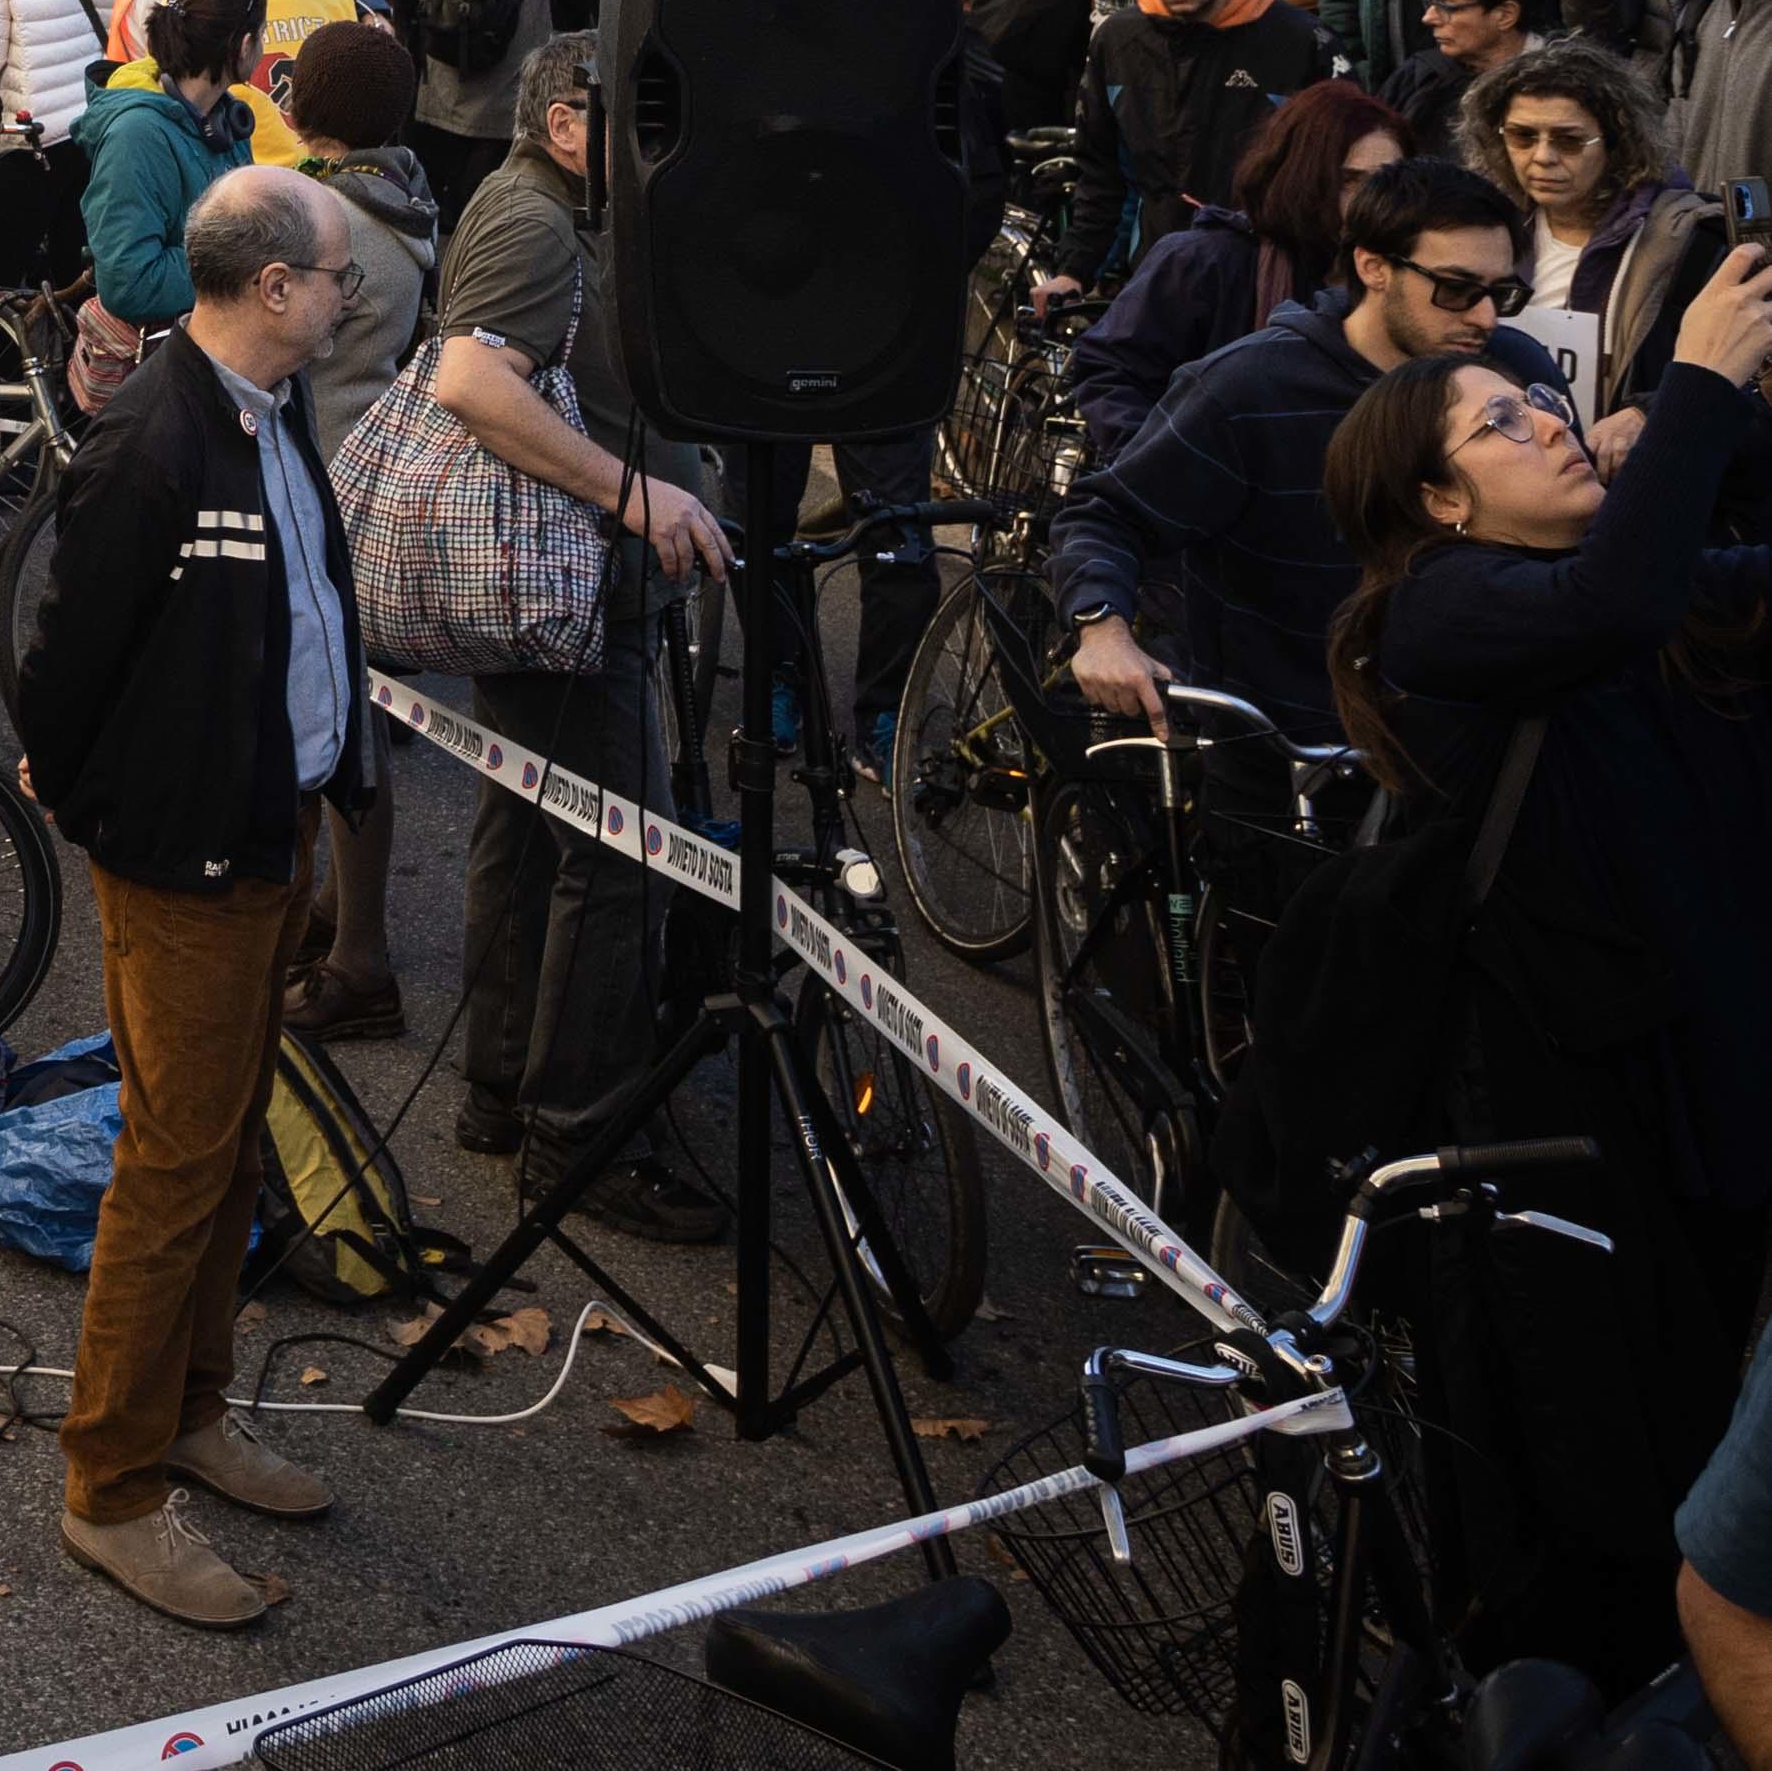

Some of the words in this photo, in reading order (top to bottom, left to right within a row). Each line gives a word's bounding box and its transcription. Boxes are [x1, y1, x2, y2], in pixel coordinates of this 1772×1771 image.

[791, 375, 838, 391] gemini
[668, 833, 698, 876] DIVIETO
[698, 847, 707, 880] DI
[708, 852, 733, 896] SOSTA
[1271, 1503, 1296, 1565] ABUS
[1286, 1691, 1304, 1754] ABUS
